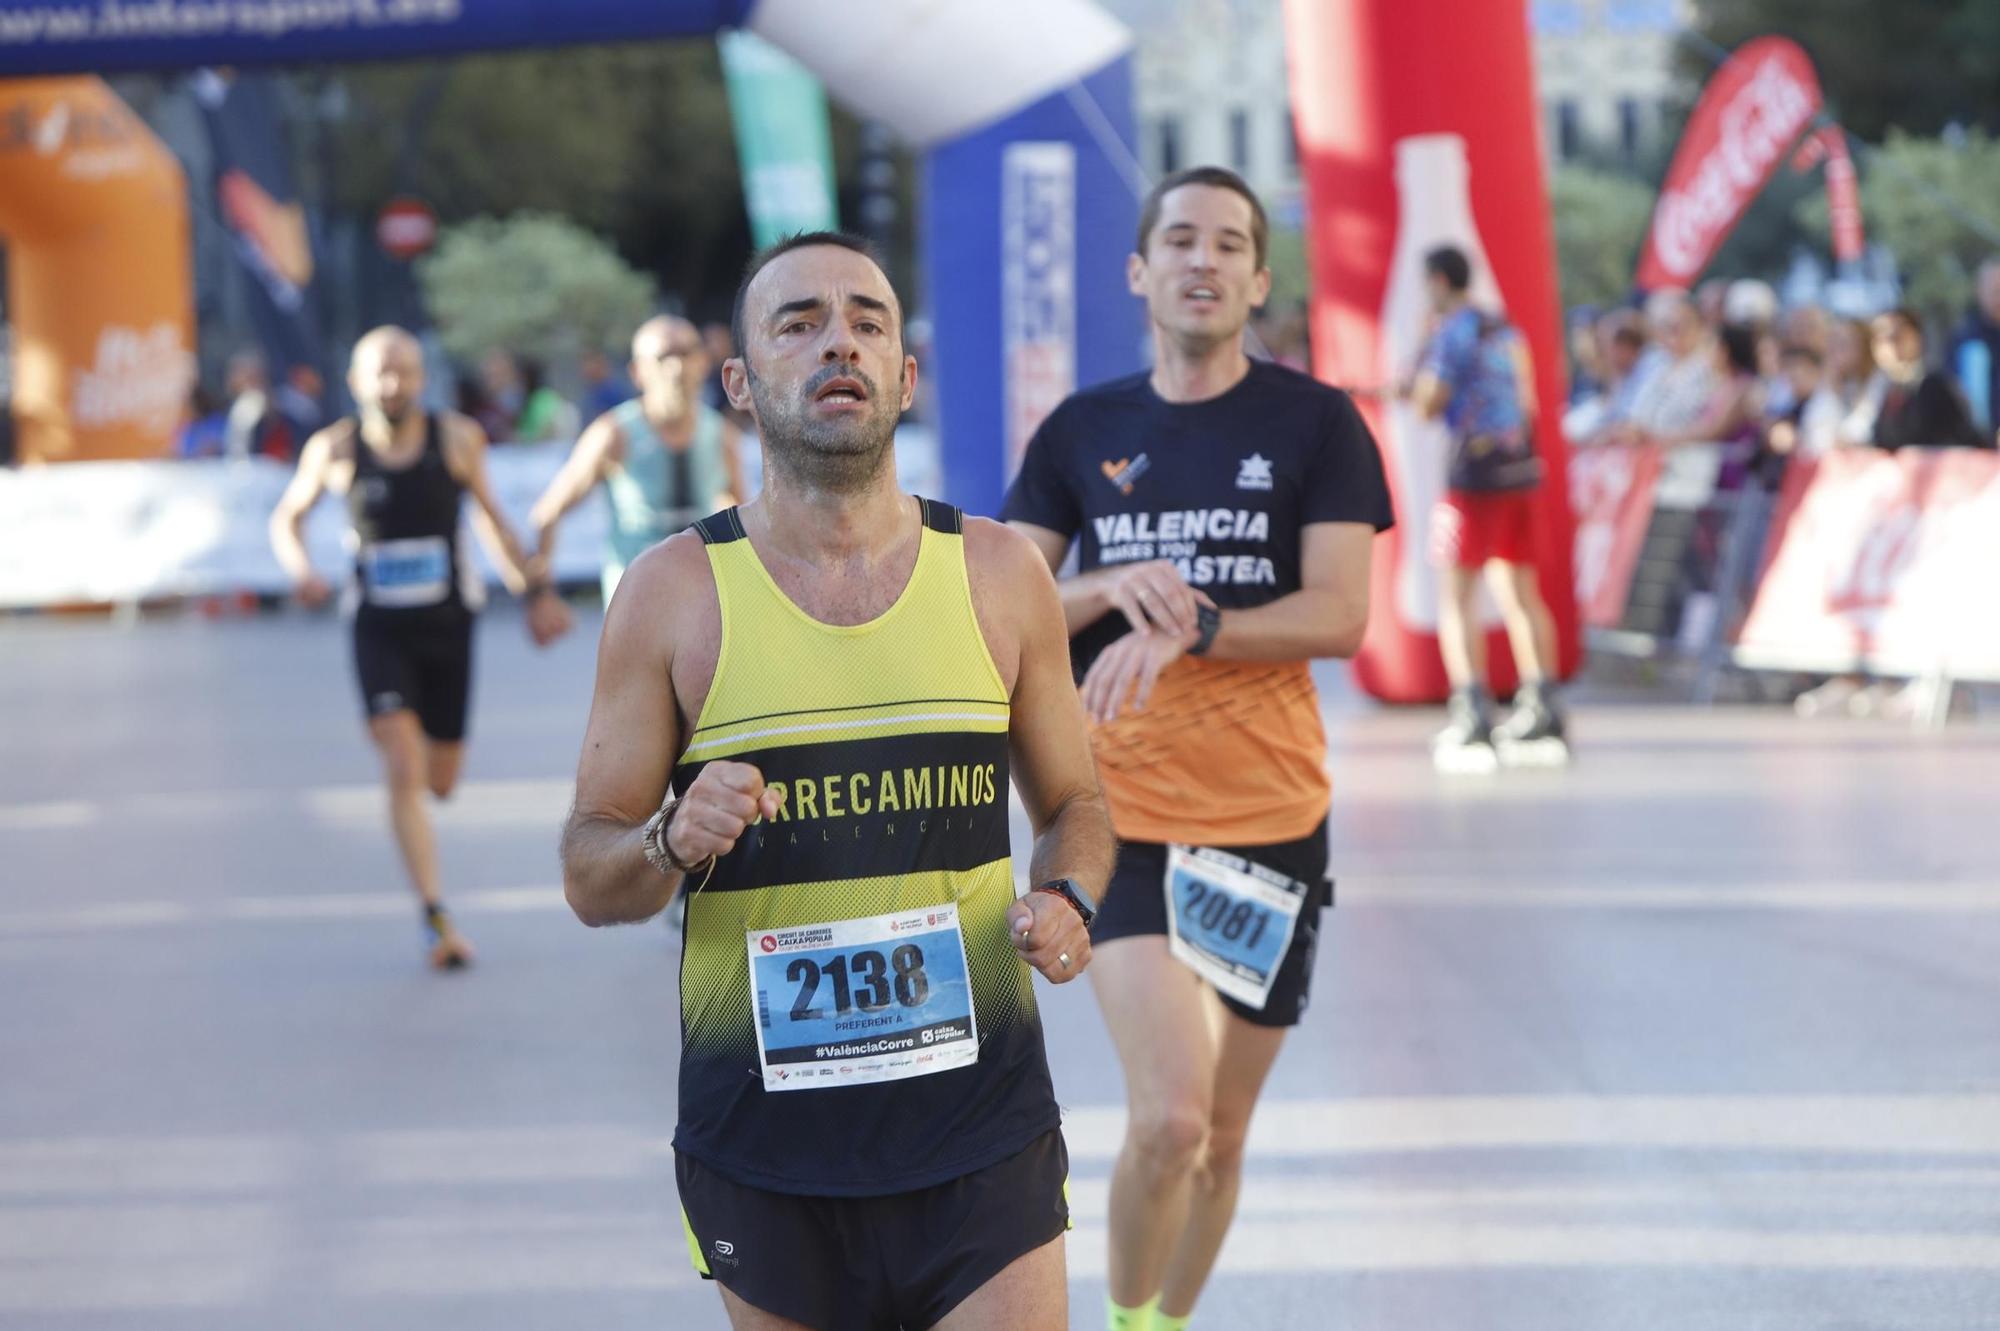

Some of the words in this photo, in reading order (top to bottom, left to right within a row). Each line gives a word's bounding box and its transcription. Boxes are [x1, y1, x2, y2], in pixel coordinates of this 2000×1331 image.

[1093, 508, 1269, 546] VALENCIA
[1159, 541, 1198, 558] YOU
[1170, 556, 1276, 585] ASTER
[750, 763, 995, 826] RRECAMINOS
[1184, 880, 1270, 949] 2081
[786, 944, 929, 1021] 2138
[835, 1016, 893, 1032] PREFERENT
[895, 1015, 904, 1024] A
[934, 1026, 955, 1035] caixa
[935, 1029, 966, 1041] popular
[815, 1037, 914, 1058] #ValènciaCorre
